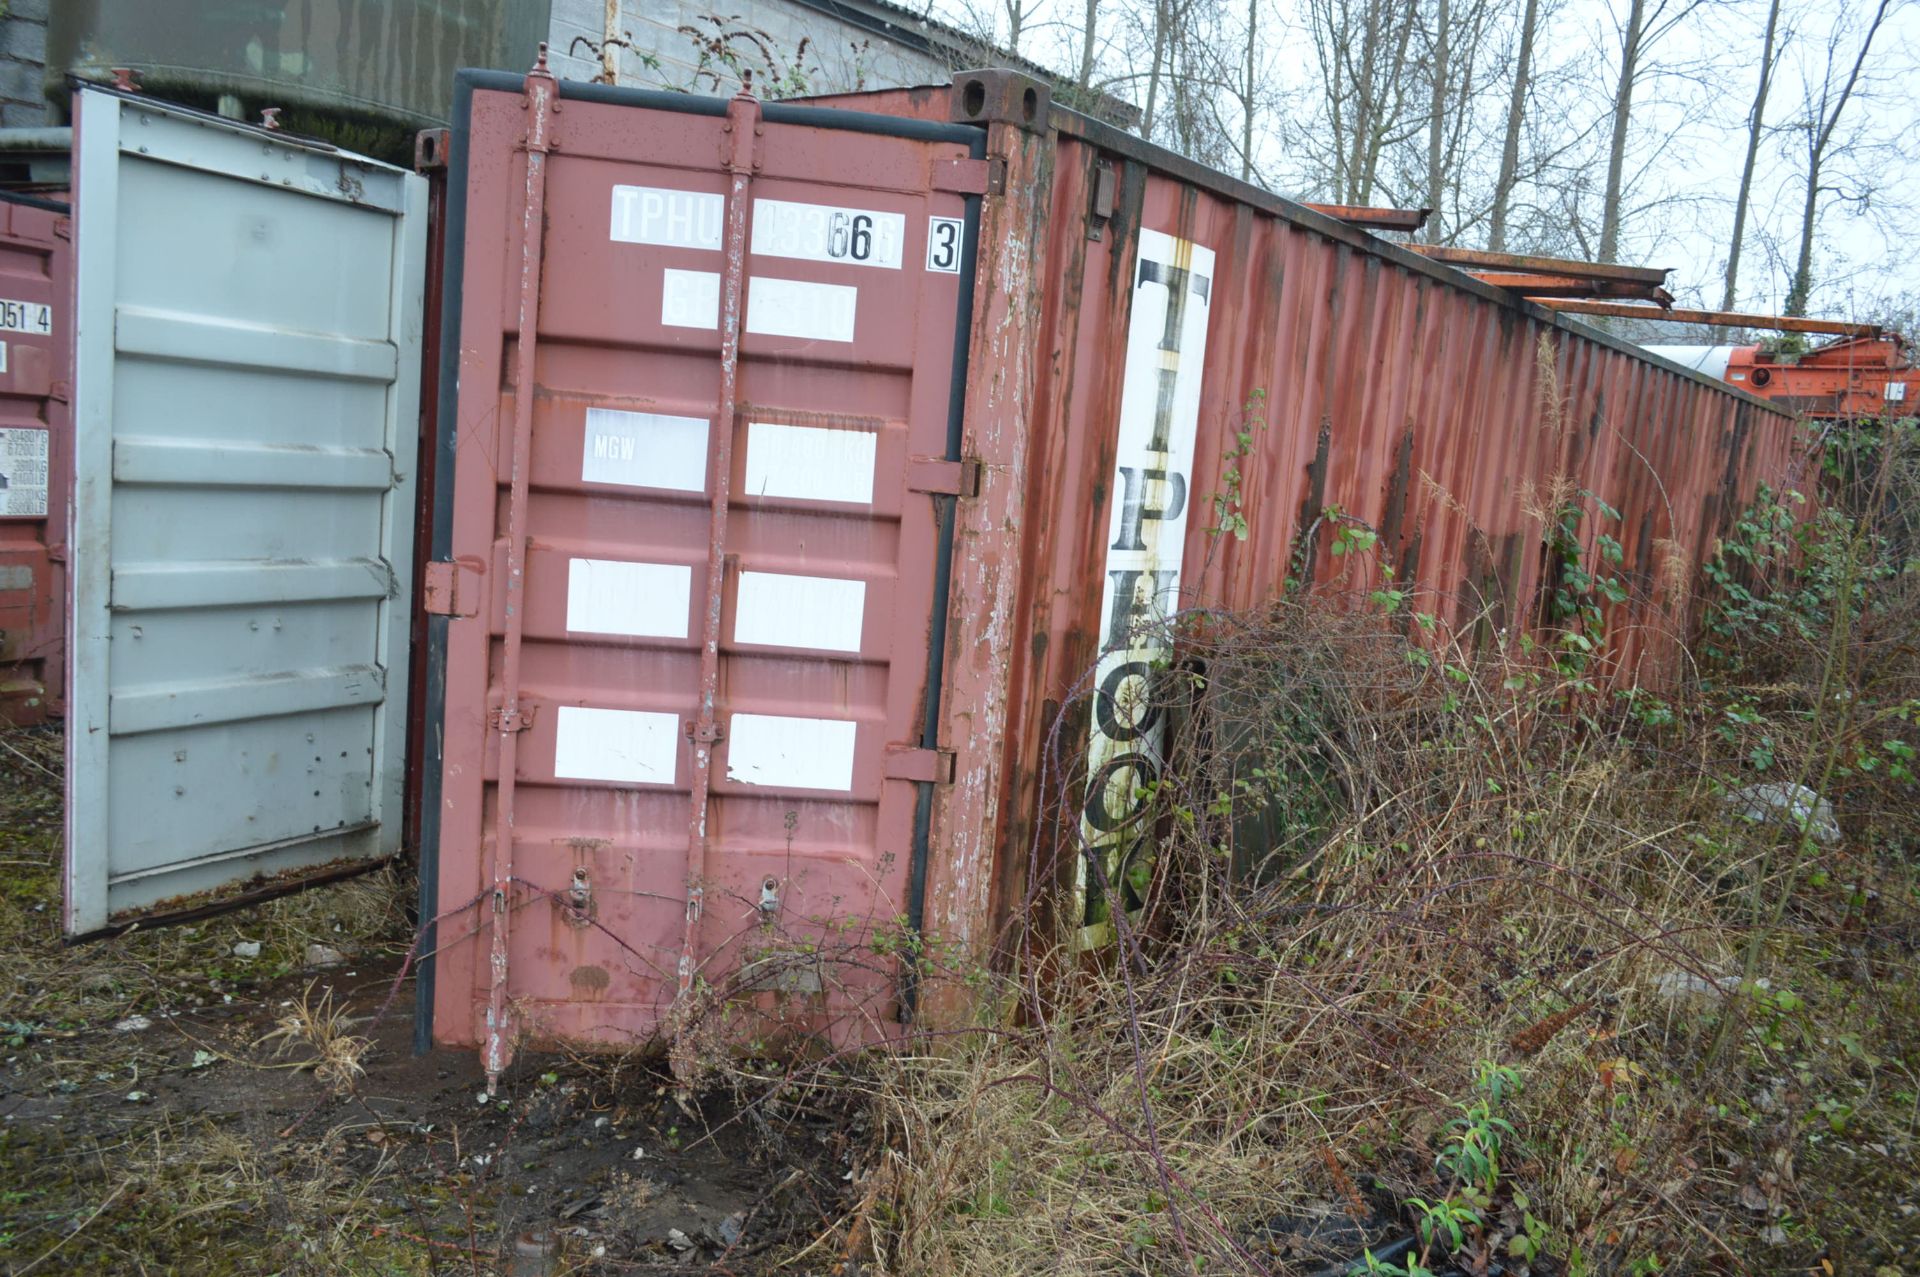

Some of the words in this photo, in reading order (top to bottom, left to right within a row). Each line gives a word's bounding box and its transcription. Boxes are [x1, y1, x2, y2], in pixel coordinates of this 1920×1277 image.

[933, 222, 955, 268] 3
[38, 307, 50, 332] 4
[593, 434, 636, 461] MGW
